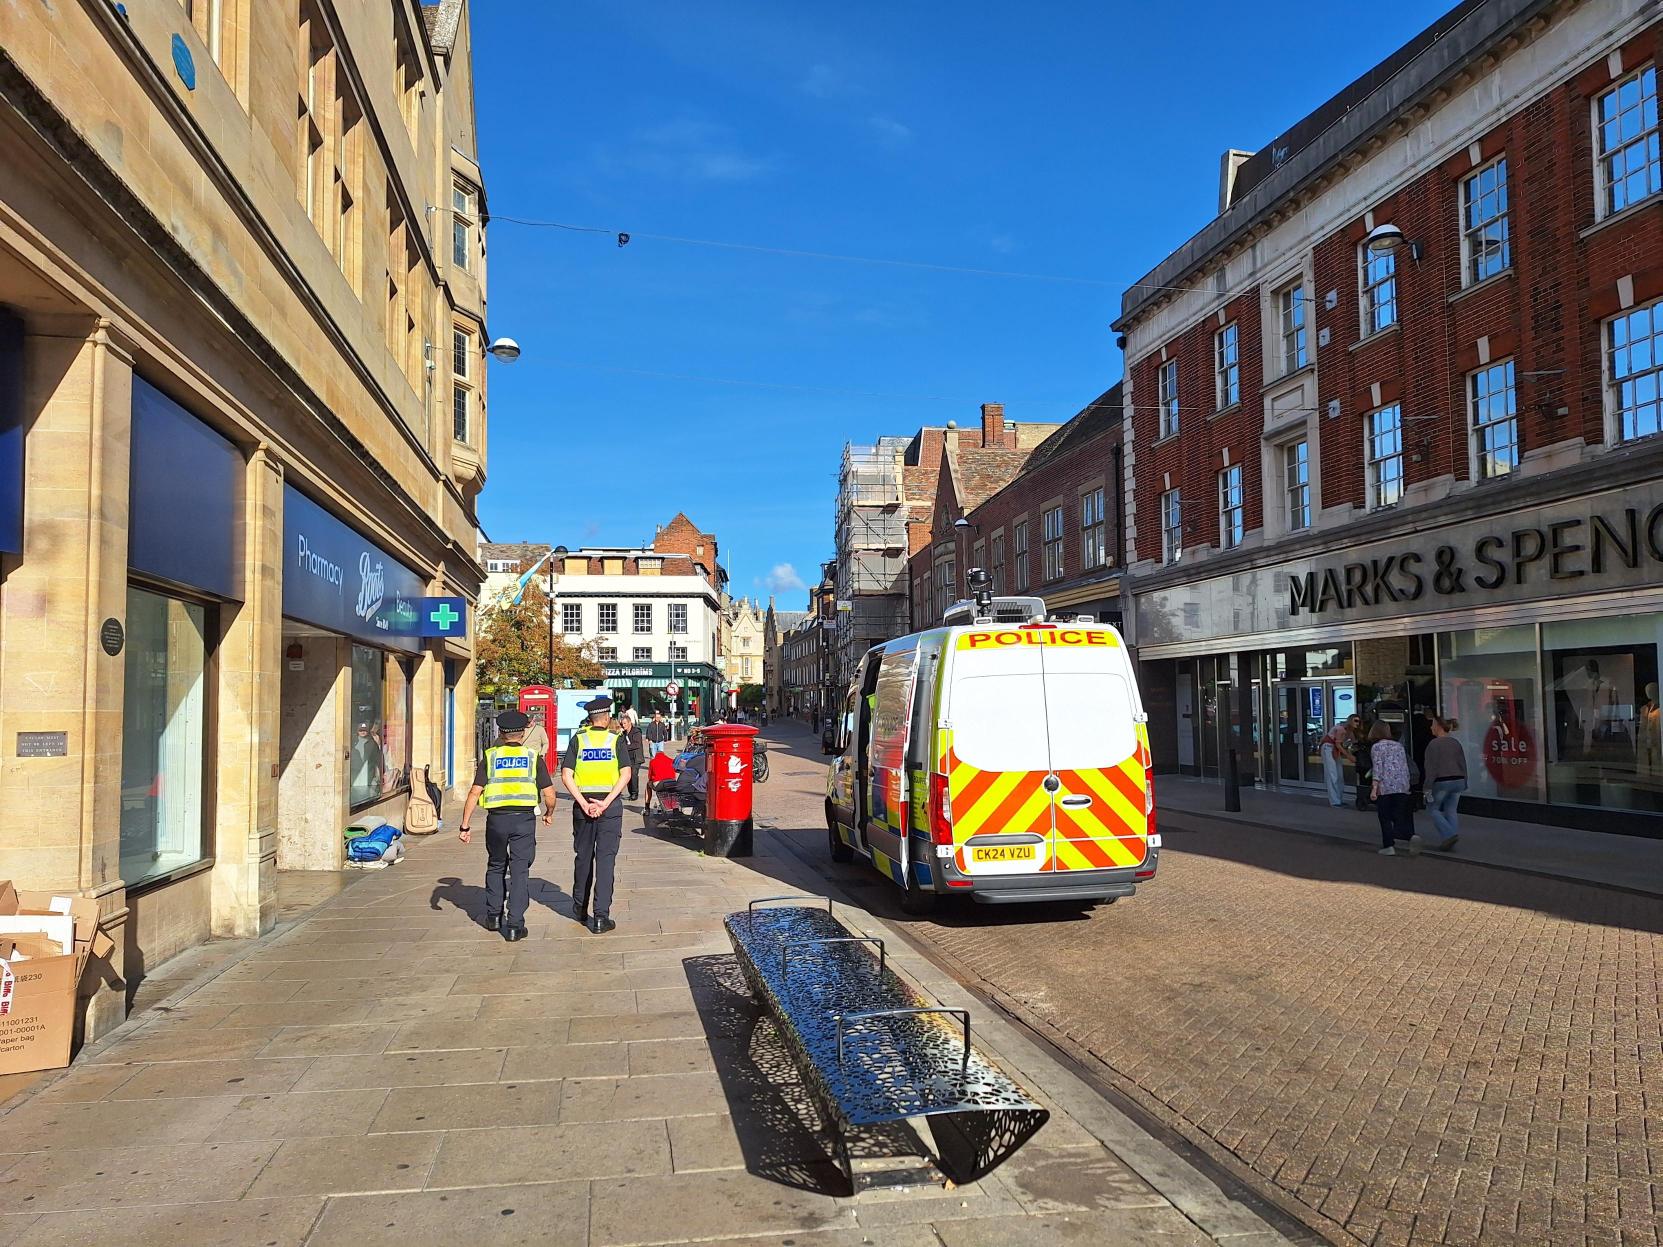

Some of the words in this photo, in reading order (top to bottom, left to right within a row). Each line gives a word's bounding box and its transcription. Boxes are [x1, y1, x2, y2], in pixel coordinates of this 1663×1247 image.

[298, 534, 344, 596] Pharmacy
[356, 551, 384, 622] Boots
[1288, 552, 1423, 616] MARKS
[1432, 545, 1466, 596] &
[968, 630, 1107, 648] POLICE
[601, 668, 620, 676] PIZZA
[1491, 737, 1527, 752] sale
[583, 749, 612, 760] POLICE
[1511, 757, 1528, 765] OFF
[496, 758, 527, 769] POLICE
[976, 848, 1006, 860] CK24
[1009, 847, 1031, 859] VZU
[0, 1037, 18, 1045] aper
